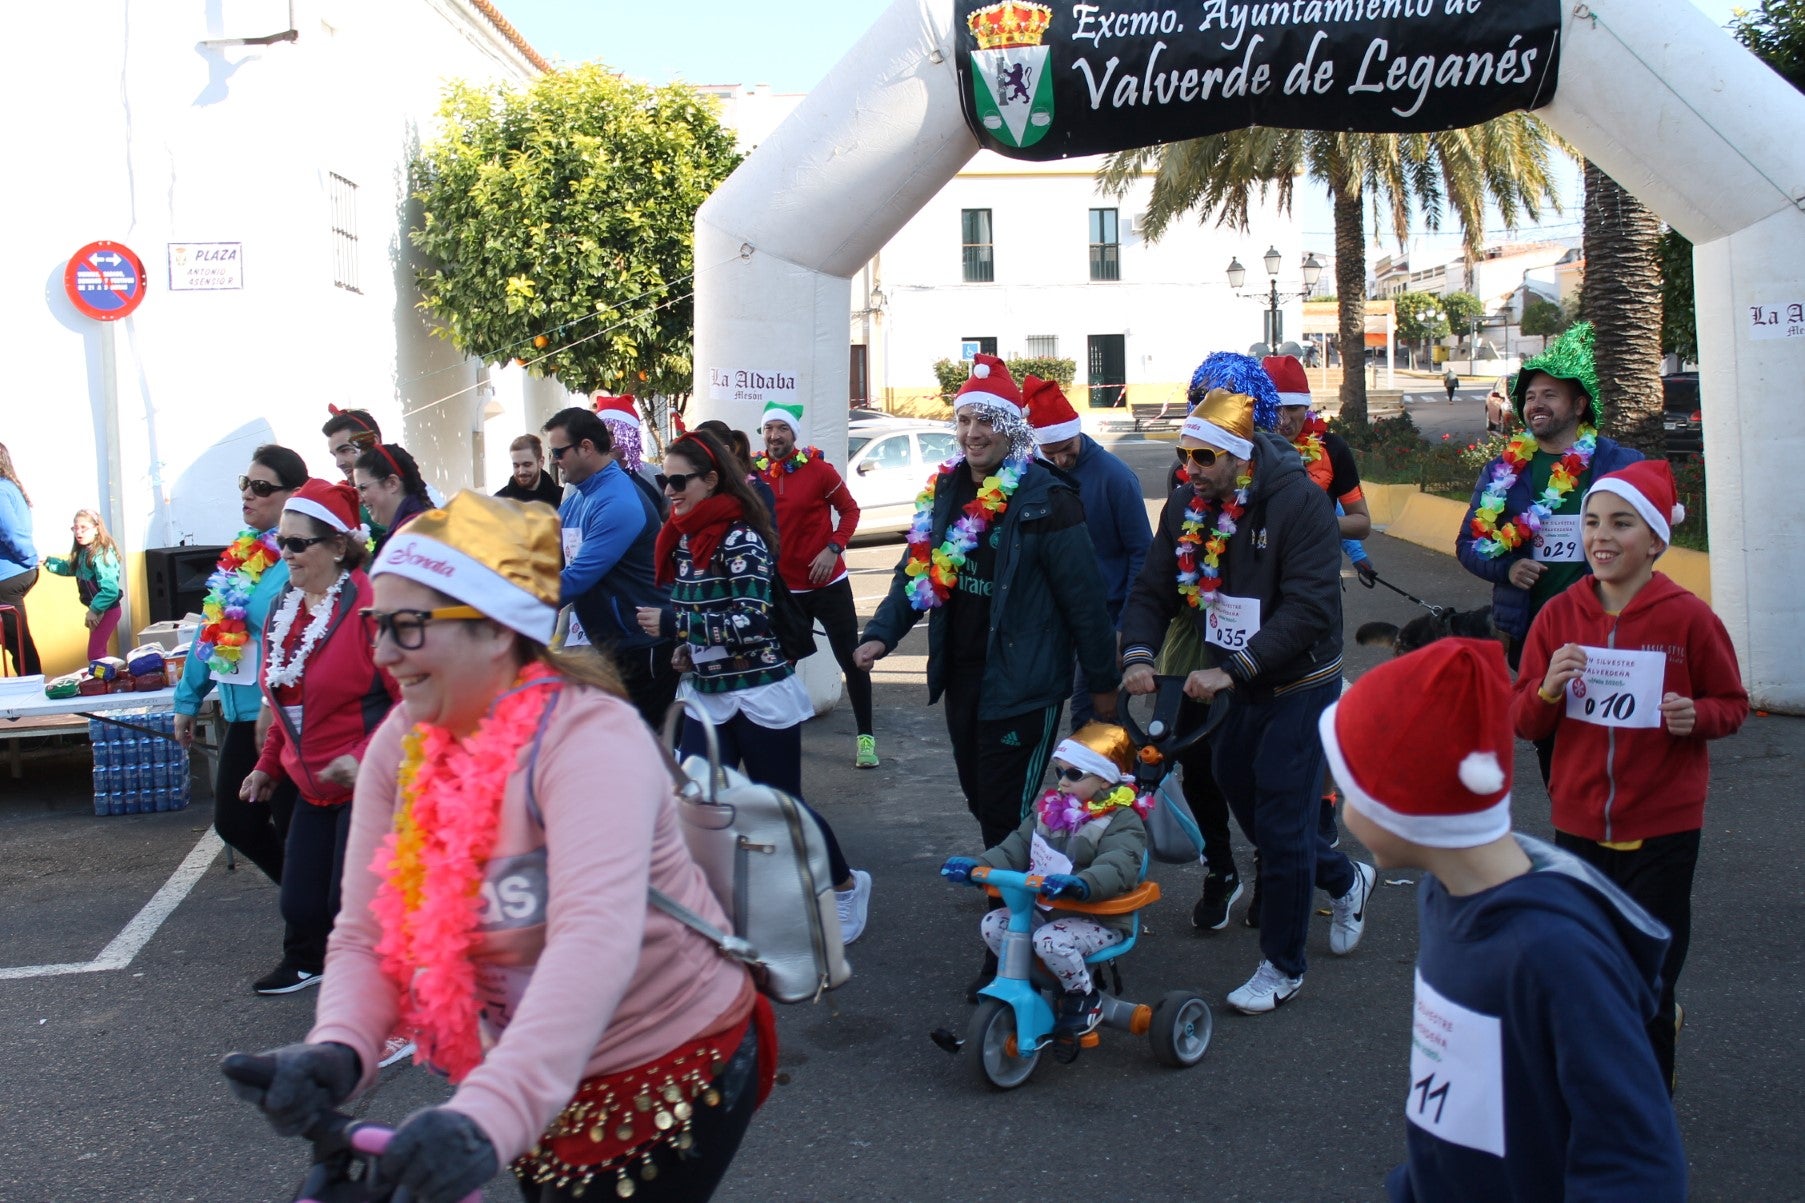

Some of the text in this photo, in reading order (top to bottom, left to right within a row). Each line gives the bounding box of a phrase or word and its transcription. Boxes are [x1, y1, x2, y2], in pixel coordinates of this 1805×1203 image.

[1071, 4, 1184, 48] Excmo.
[1199, 0, 1433, 50] Ayuntamiento
[1071, 30, 1538, 118] Valverde de Leganés
[195, 249, 237, 261] PLAZA
[187, 268, 226, 276] ANTONIO
[1750, 305, 1779, 326] La
[711, 368, 795, 390] La Aldaba
[386, 542, 457, 578] Sonata
[1543, 541, 1577, 558] 029
[1216, 628, 1247, 647] 035
[1596, 658, 1635, 667] SILVESTRE
[1584, 692, 1636, 720] 010
[1415, 1072, 1451, 1124] 11
